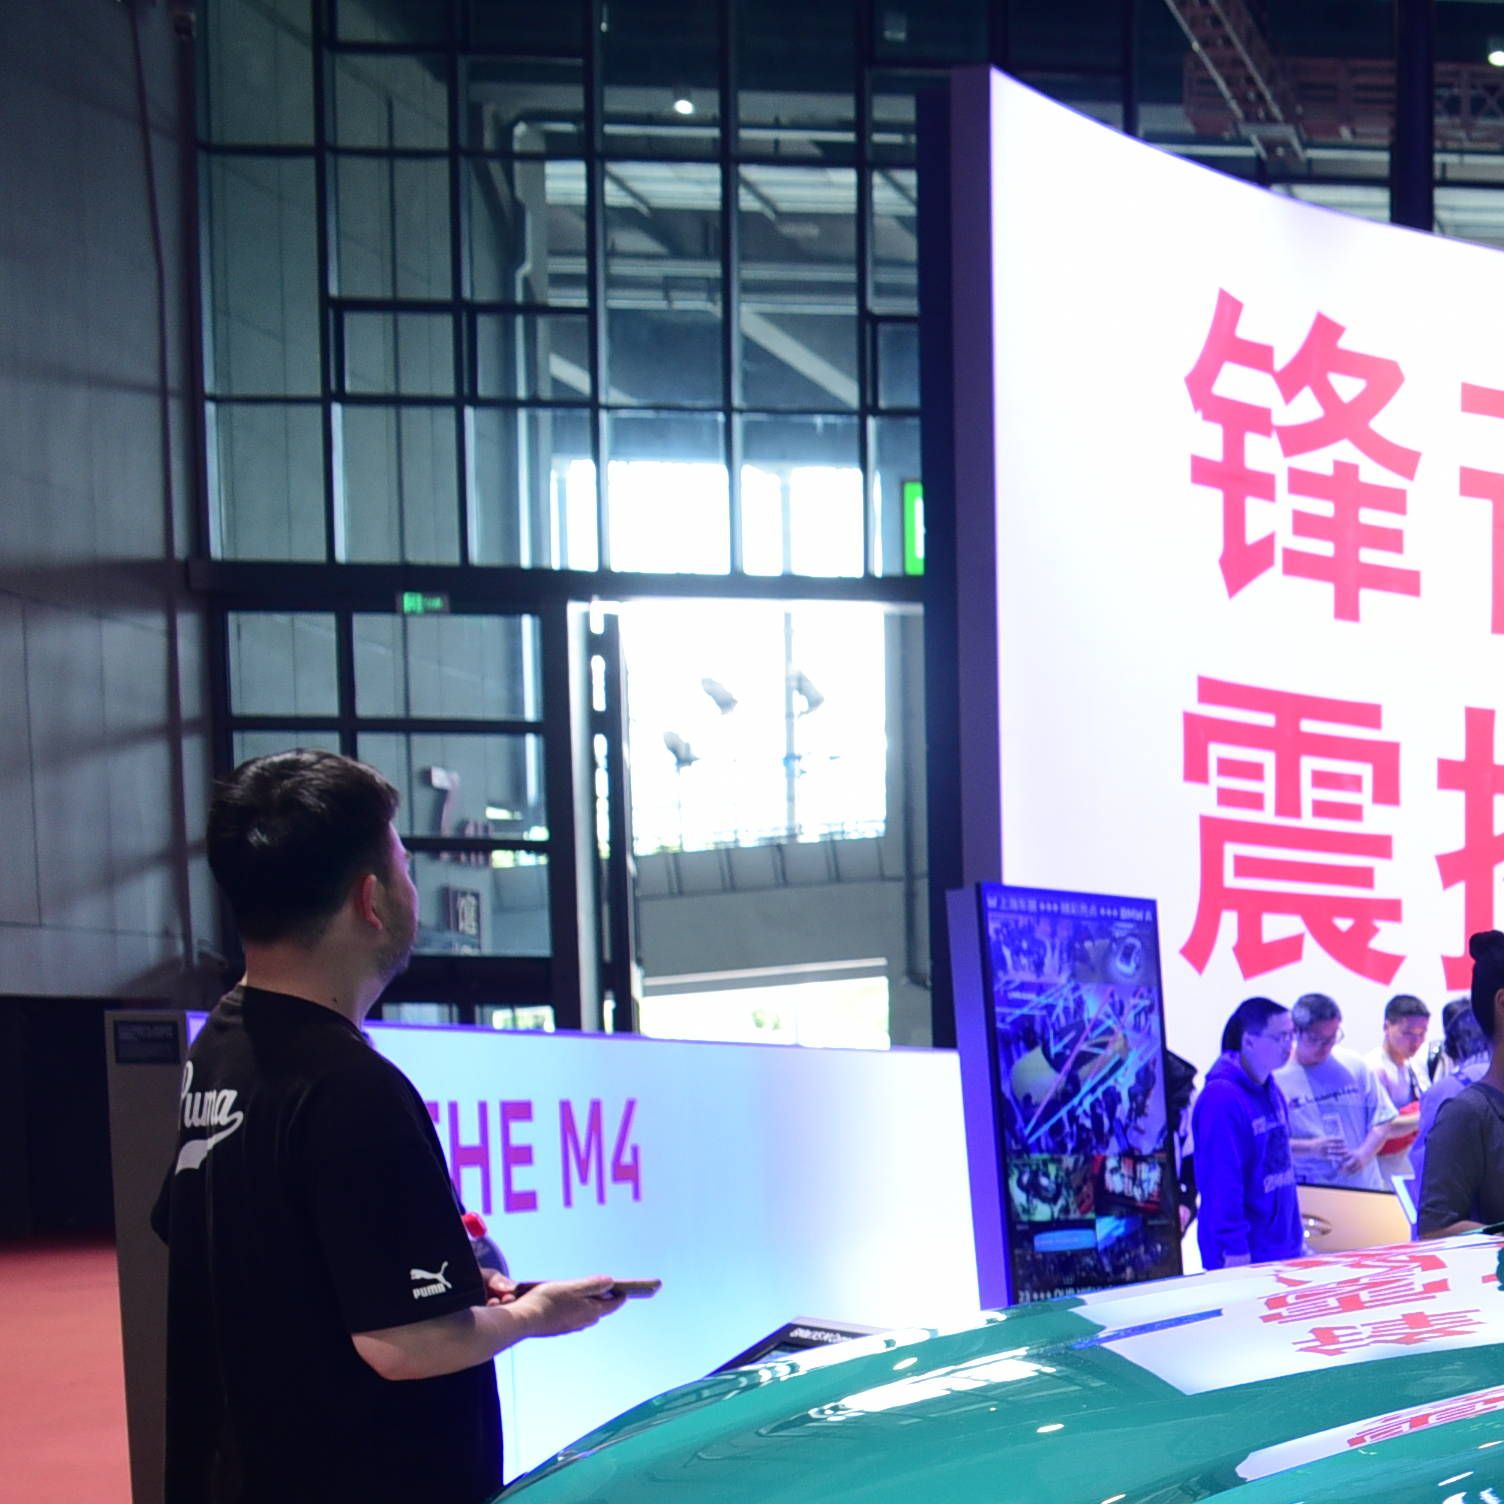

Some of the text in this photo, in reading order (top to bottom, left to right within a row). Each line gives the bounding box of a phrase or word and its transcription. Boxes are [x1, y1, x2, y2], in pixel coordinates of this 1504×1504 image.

[424, 1097, 641, 1216] HE M4
[412, 1283, 446, 1301] PUMA
